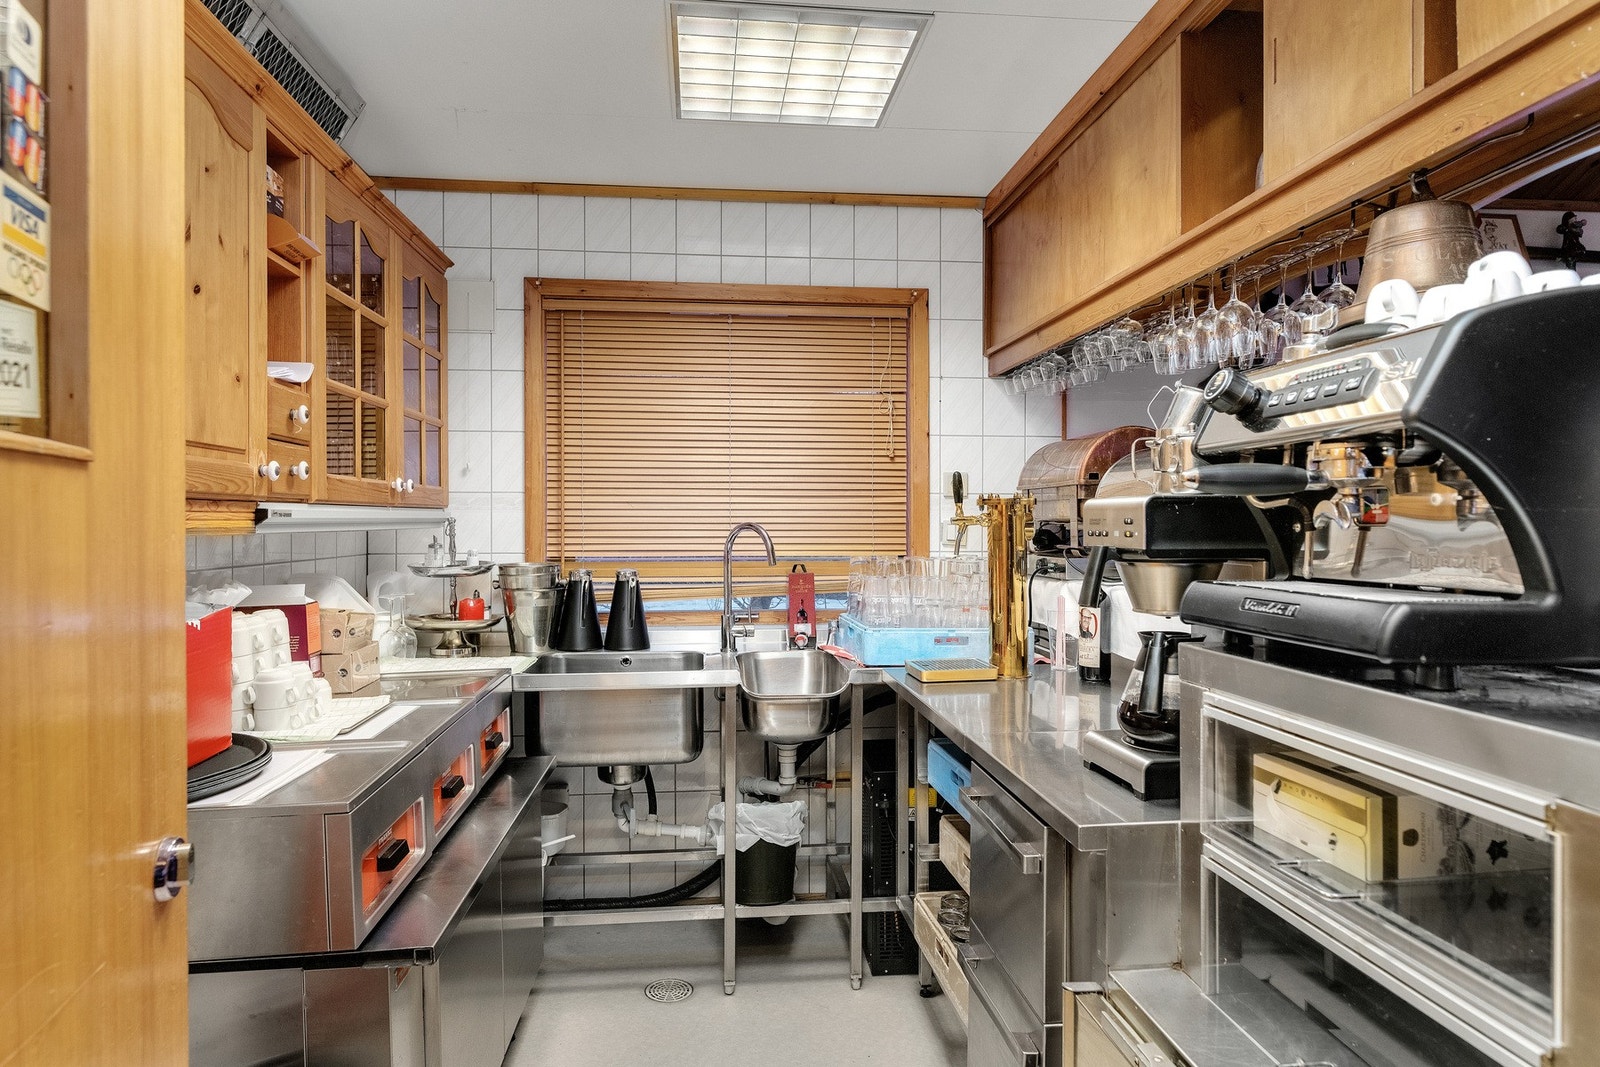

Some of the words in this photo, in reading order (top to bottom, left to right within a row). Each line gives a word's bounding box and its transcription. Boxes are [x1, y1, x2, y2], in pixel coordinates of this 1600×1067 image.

[11, 205, 40, 240] VISA
[0, 361, 31, 389] 021
[1243, 598, 1284, 616] Vivaldi
